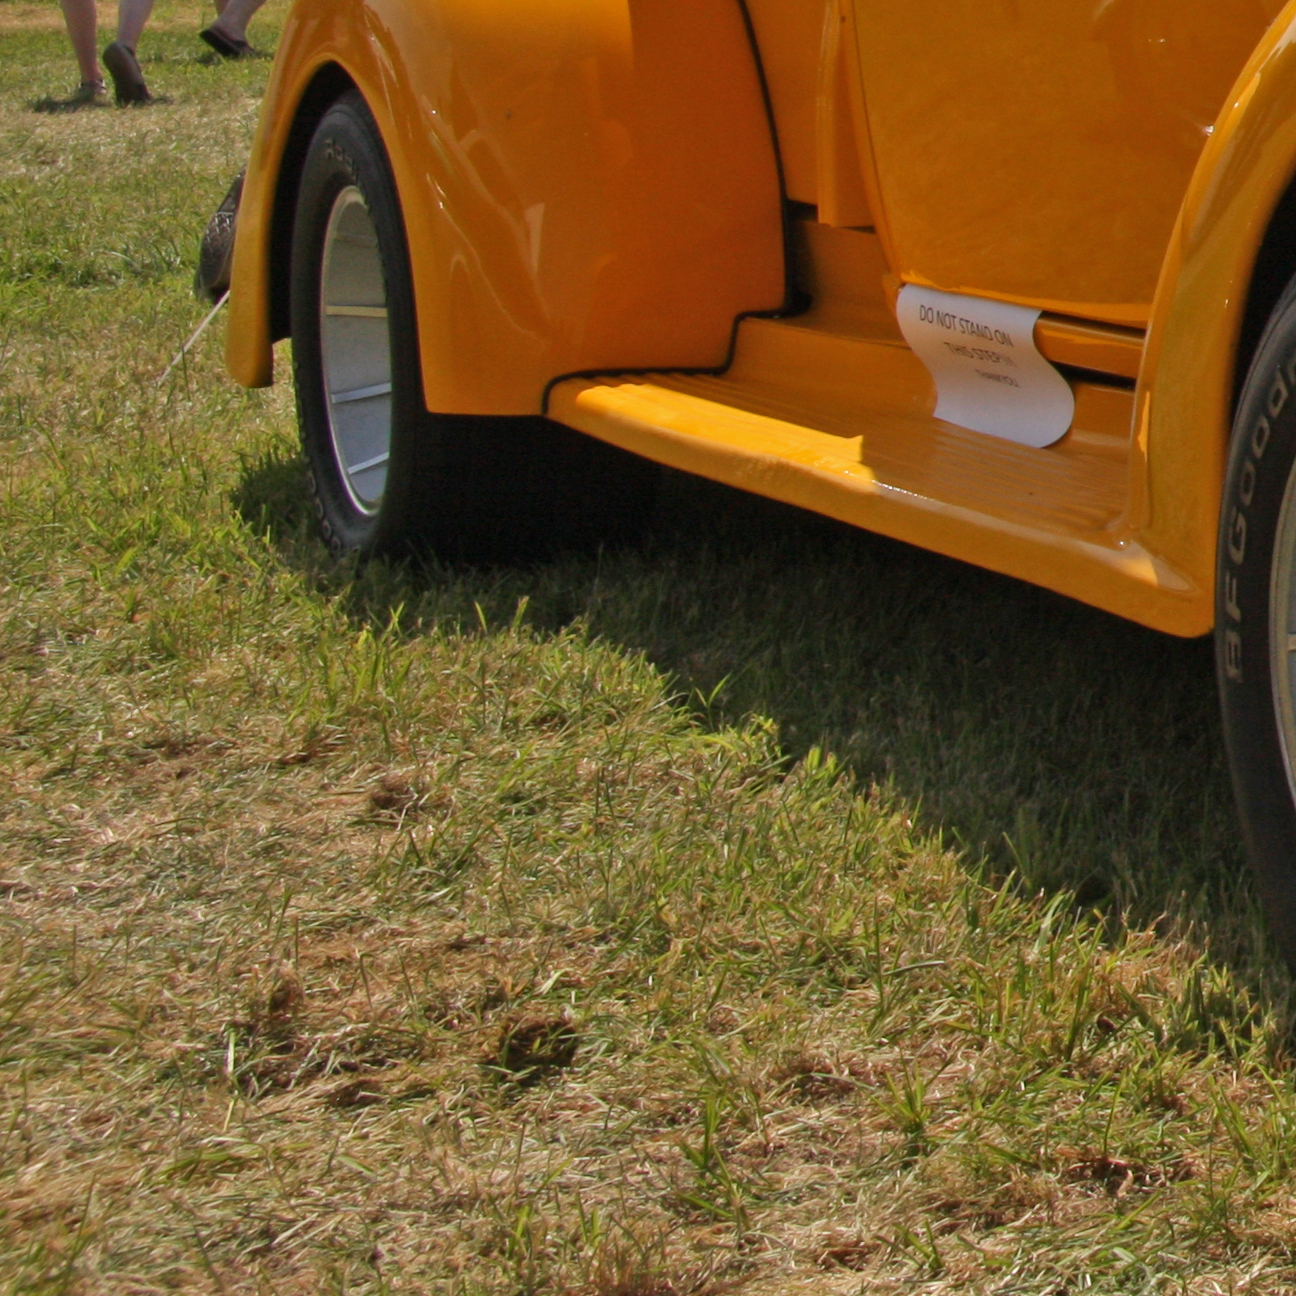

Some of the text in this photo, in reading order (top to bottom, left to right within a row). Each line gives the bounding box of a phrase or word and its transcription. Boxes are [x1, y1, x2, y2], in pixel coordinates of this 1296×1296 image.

[919, 304, 1014, 347] DO NOT STAND ON
[943, 341, 974, 358] THIS
